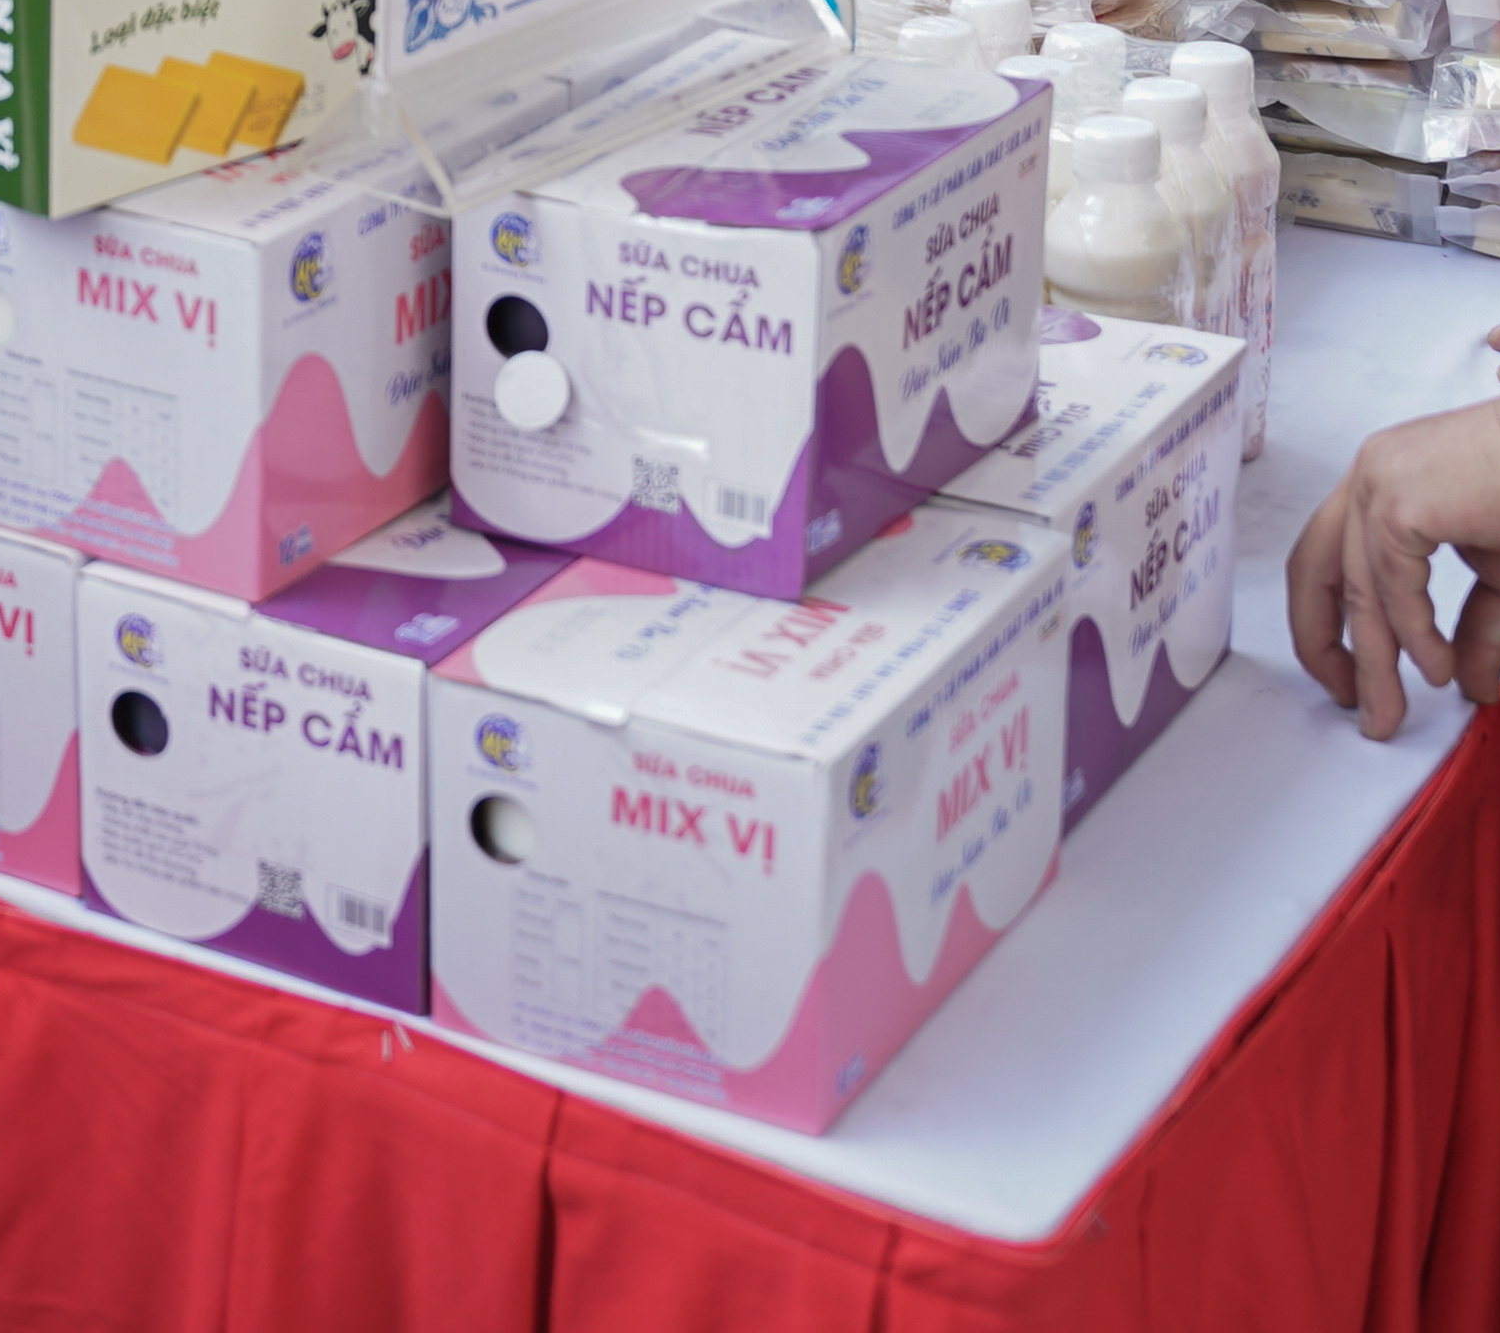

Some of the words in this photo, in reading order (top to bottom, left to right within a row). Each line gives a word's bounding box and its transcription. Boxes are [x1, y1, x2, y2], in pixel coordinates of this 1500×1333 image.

[88, 17, 137, 55] Loại
[140, 5, 175, 31] đặc
[94, 233, 135, 264] SỮA
[140, 245, 200, 278] CHUA
[409, 222, 446, 261] SỮA
[618, 236, 672, 273] SỮA
[680, 254, 762, 290] CHUA
[926, 225, 955, 264] SỮA
[959, 195, 999, 239] CHUA
[76, 266, 159, 325] MIX
[176, 291, 221, 351] VỊ
[585, 274, 668, 330] NẾP
[683, 291, 795, 357] CẨM
[904, 270, 951, 345] NẾP
[957, 235, 1012, 308] CẨM
[1145, 489, 1170, 527] SỮA
[1171, 454, 1206, 501] CHUA
[1131, 533, 1168, 608] NẾP
[1172, 494, 1218, 564] CẨM
[238, 644, 291, 679] SỮA
[298, 662, 374, 702] CHUA
[208, 682, 287, 733] NẾP
[301, 700, 406, 771] CẨM
[632, 750, 680, 782] SỮA
[687, 765, 758, 801] CHUA
[937, 752, 990, 838] MIX
[1001, 709, 1029, 770] VỊ
[610, 785, 709, 845] MIX
[724, 817, 778, 877] VỊ
